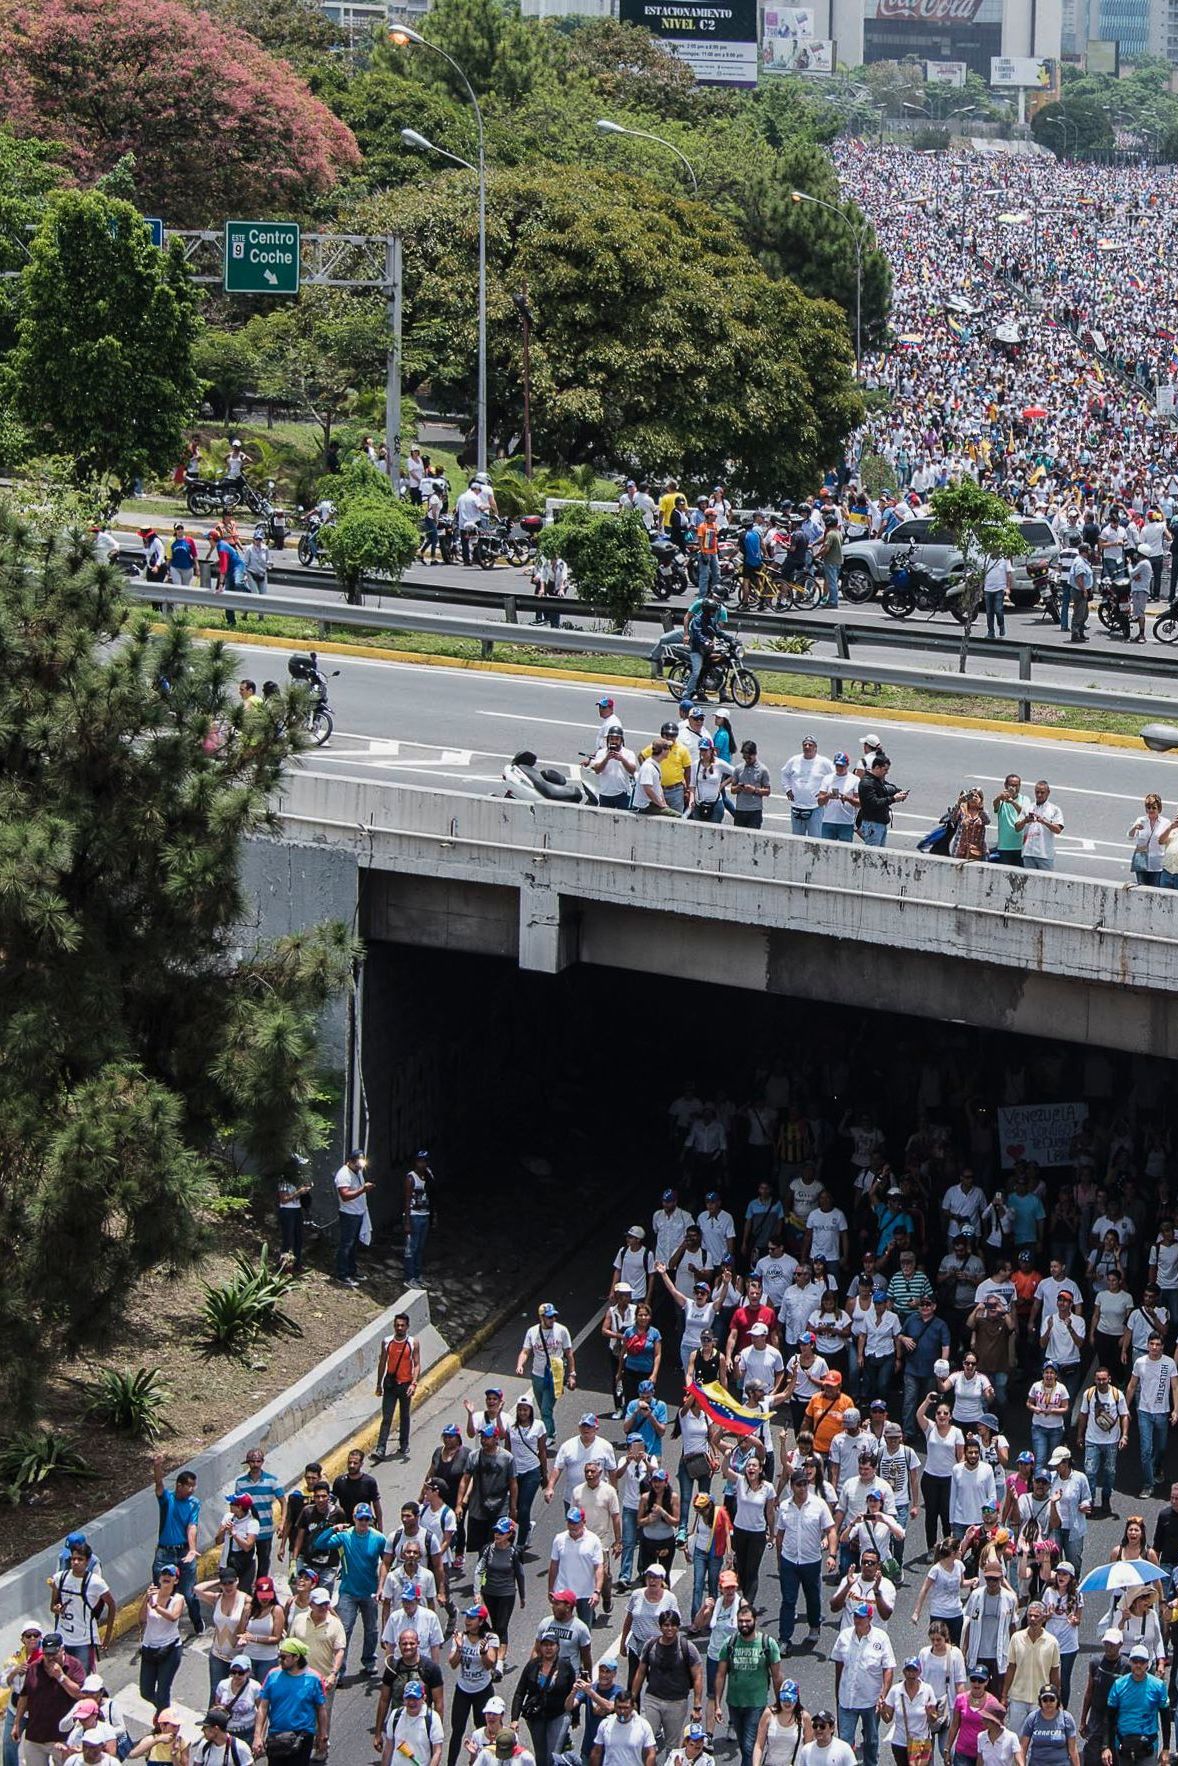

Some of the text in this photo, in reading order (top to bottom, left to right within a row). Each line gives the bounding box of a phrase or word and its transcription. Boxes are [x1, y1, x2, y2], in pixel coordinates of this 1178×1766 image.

[644, 6, 732, 18] ESTACIONAMIENTO
[661, 18, 716, 31] NIVEL C2
[231, 229, 294, 245] ESTE Centro
[234, 244, 293, 265] 9 Coche
